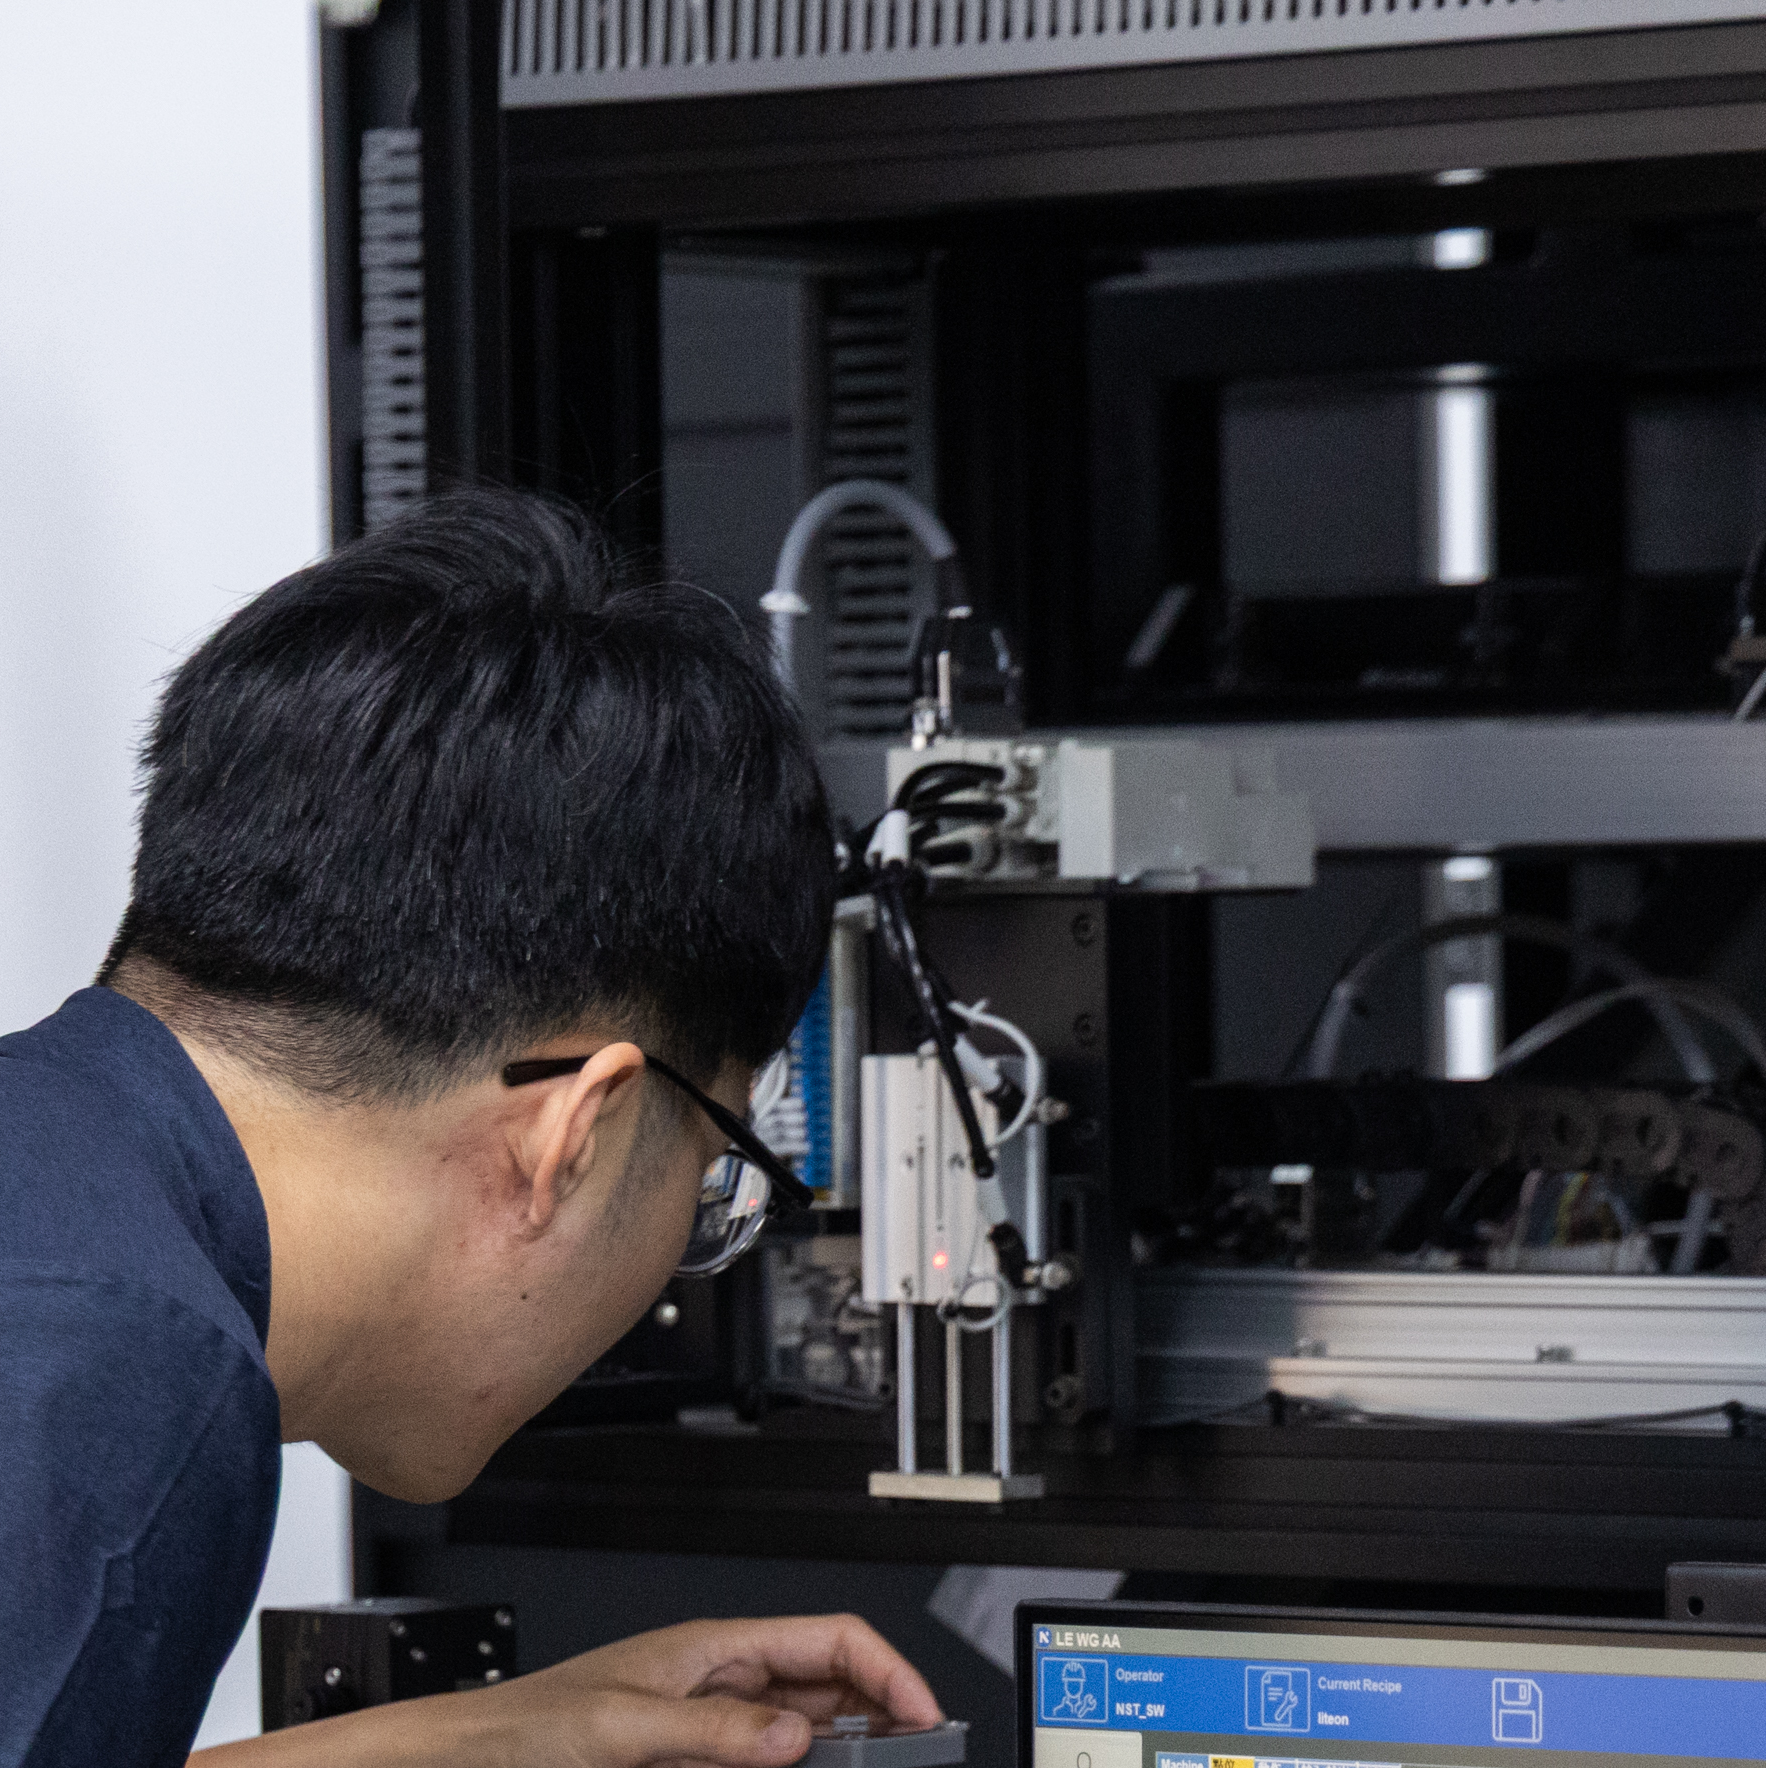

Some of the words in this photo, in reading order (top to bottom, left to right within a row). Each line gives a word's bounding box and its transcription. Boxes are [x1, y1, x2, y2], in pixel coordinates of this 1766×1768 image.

[1056, 1632, 1077, 1647] LE
[1079, 1633, 1099, 1648] WG
[1101, 1634, 1121, 1649] AA
[1115, 1668, 1165, 1684] Operator
[1317, 1676, 1361, 1692] Current
[1362, 1679, 1402, 1695] Recipe
[1115, 1702, 1165, 1719] NST_SW
[1317, 1711, 1350, 1727] liteon
